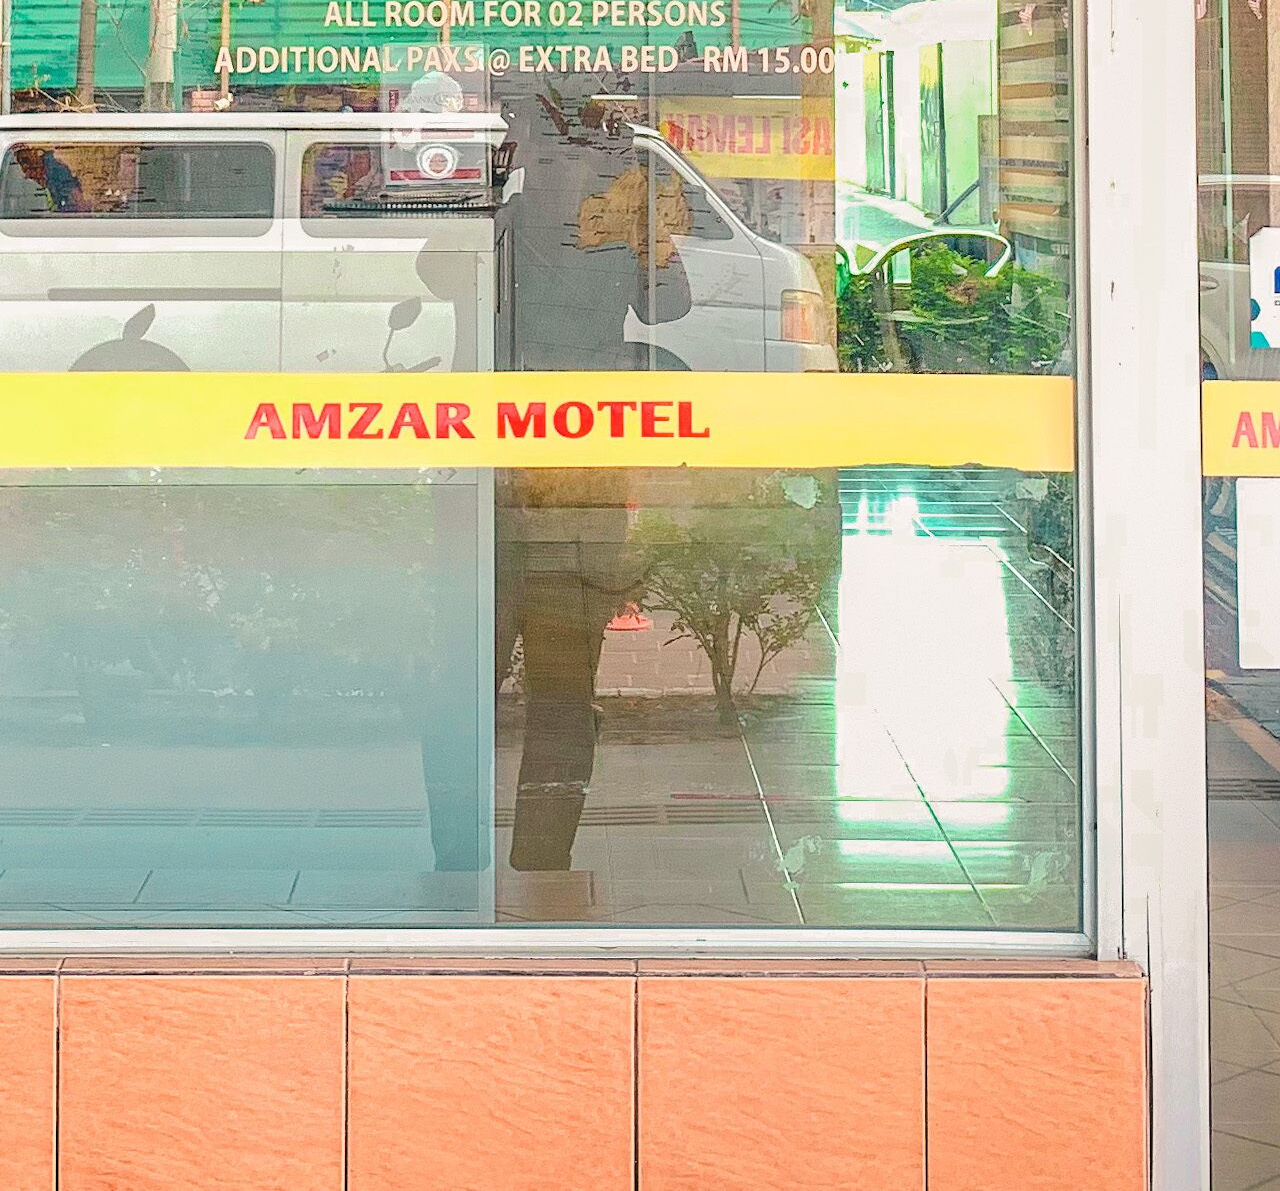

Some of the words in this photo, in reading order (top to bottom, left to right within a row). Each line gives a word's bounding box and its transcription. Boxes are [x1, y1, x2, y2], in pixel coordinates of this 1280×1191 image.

[324, 1, 376, 27] ALL
[385, 1, 475, 27] ROOM
[484, 0, 540, 27] FOR
[548, 0, 583, 27] 02
[592, 0, 726, 27] PERSONS
[214, 46, 398, 74] ADDITIONAL
[407, 47, 480, 73] PAXS
[488, 49, 510, 76] @
[621, 45, 679, 73] BED
[704, 46, 748, 73] RM
[757, 47, 835, 74] 15.00
[244, 402, 476, 440] AMZAR
[497, 401, 710, 439] MOTEL
